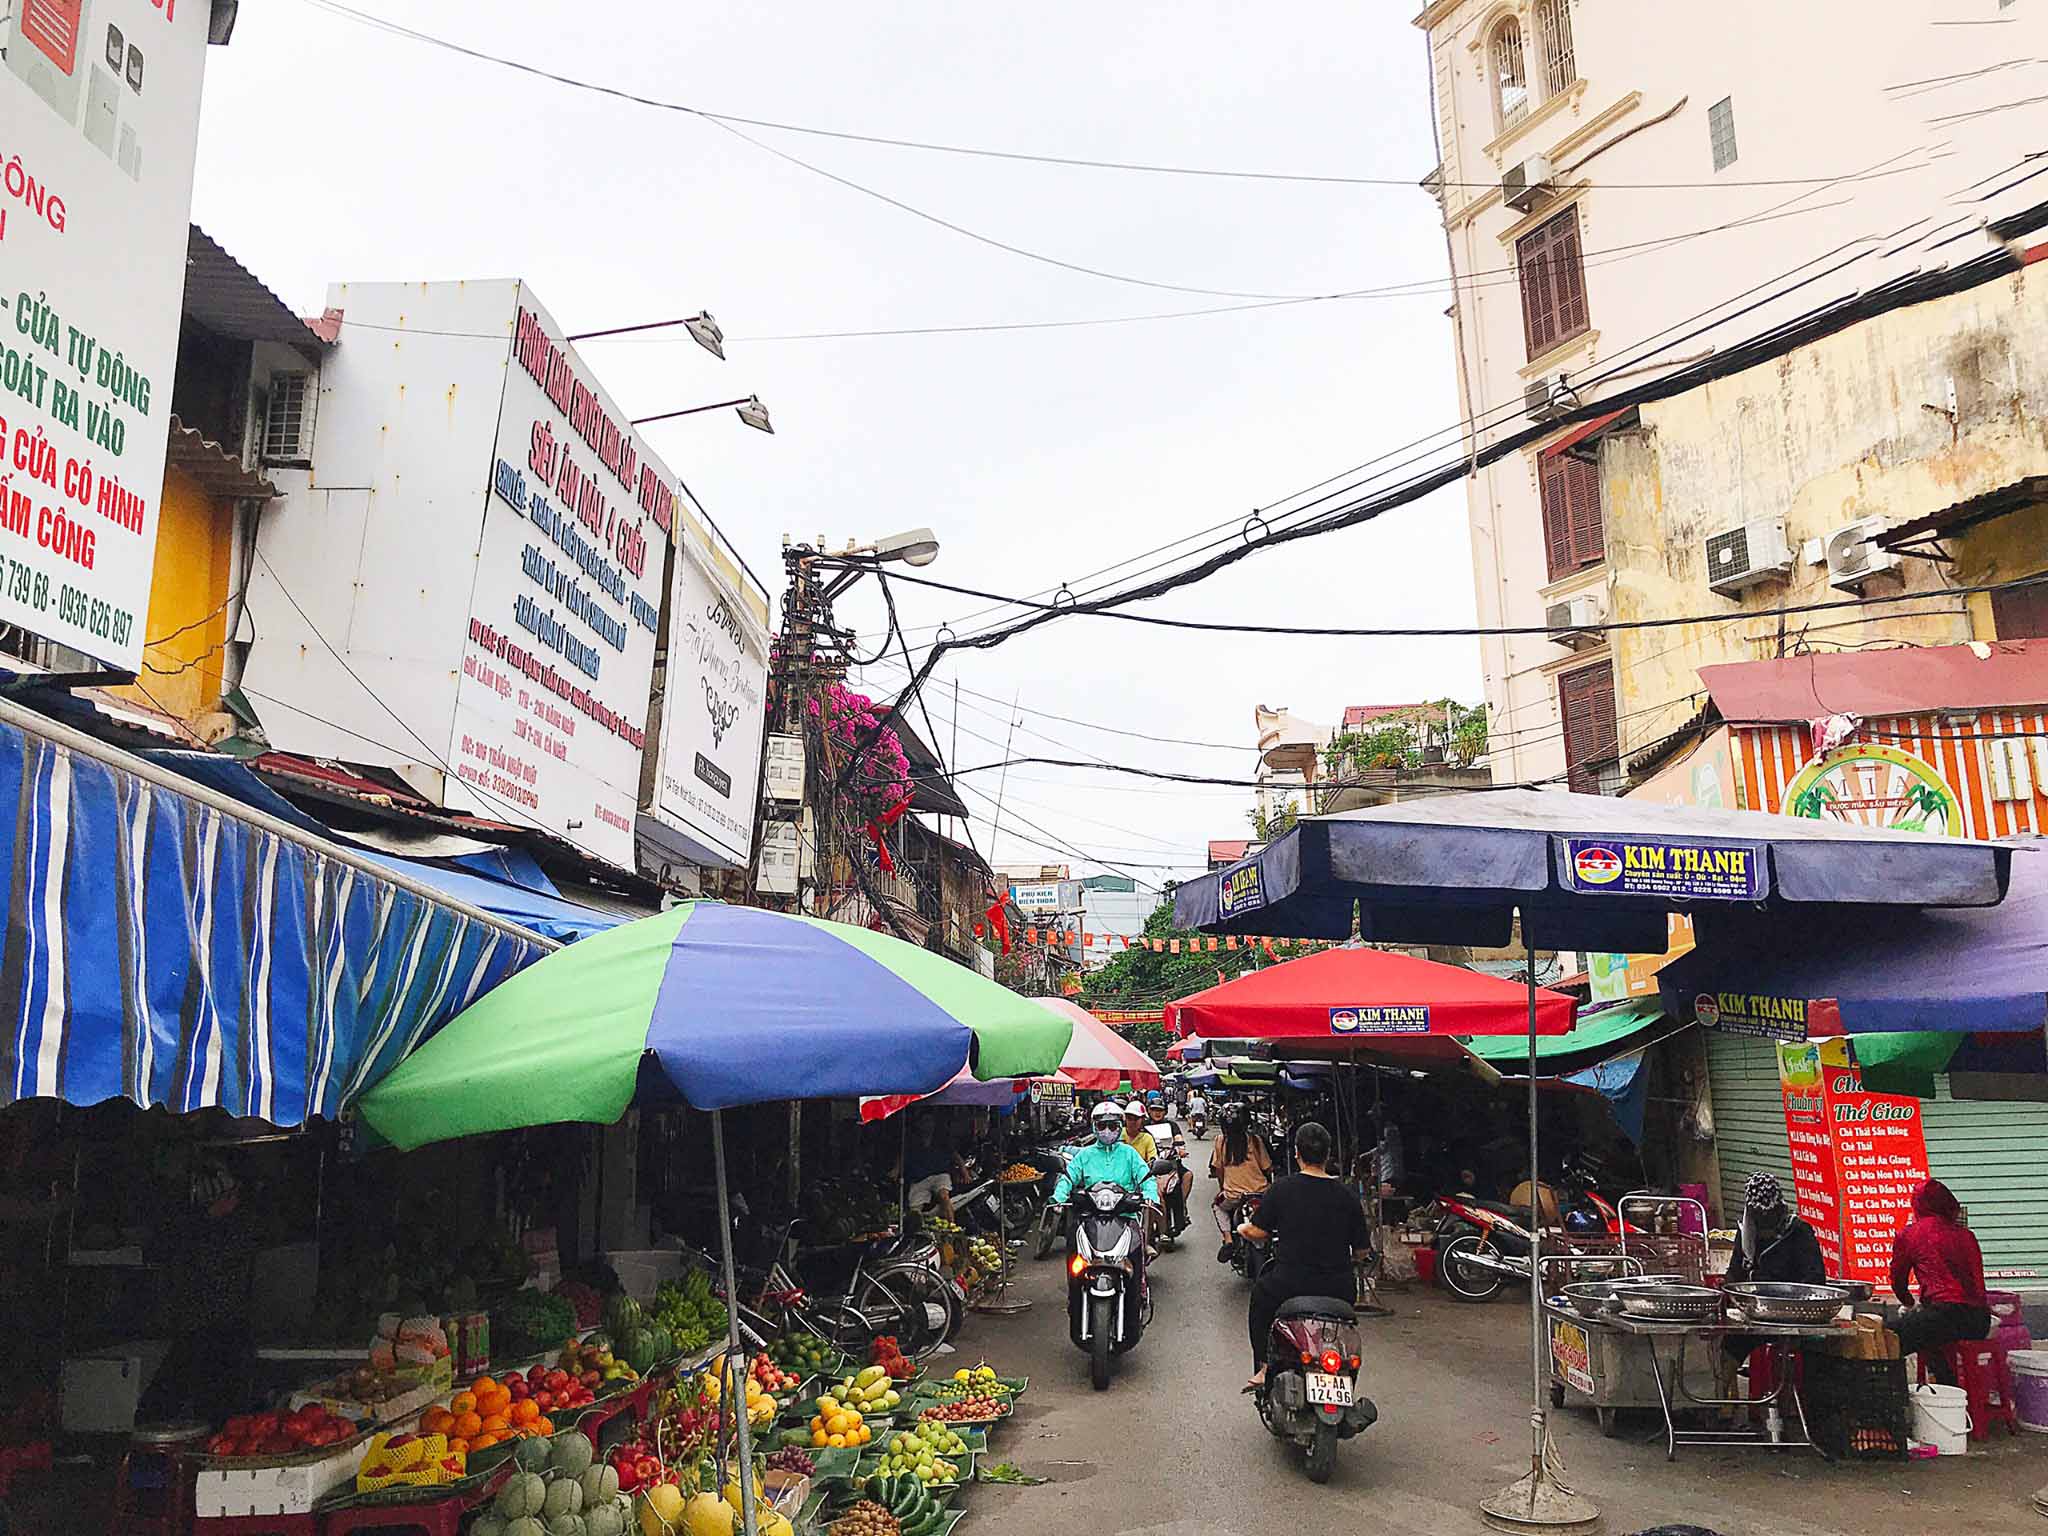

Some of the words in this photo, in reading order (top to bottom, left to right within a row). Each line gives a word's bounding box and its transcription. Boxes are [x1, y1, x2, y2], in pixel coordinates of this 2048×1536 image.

[0, 154, 66, 234] ÔNG
[15, 291, 60, 357] CỬA
[68, 326, 97, 384] TỰ
[96, 352, 151, 417] ĐỘNG
[514, 305, 550, 387] PHÒNG
[544, 345, 574, 418] KHÁM
[52, 378, 79, 433] RA
[86, 398, 125, 458] VÀO
[13, 424, 57, 491] CỬA
[64, 458, 93, 507] CÓ
[96, 473, 145, 537] HÌNH
[528, 420, 560, 488] SIÊU
[556, 442, 580, 512] ÂM
[577, 473, 606, 538] MÀU
[605, 507, 617, 550] 4
[616, 517, 648, 580] CHIỀU
[36, 506, 96, 571] CÔNG
[9, 559, 31, 606] 739
[33, 570, 49, 614] 68
[59, 582, 89, 630] 0936
[89, 596, 112, 640] 626
[113, 608, 134, 648] 897
[480, 624, 498, 653] BÁC
[1624, 846, 1666, 870] KIM
[1670, 848, 1746, 875] THANH
[1358, 1008, 1380, 1021] KIM
[1382, 1008, 1424, 1021] THANH
[1718, 993, 1746, 1015] KIM
[1749, 995, 1804, 1021] THANH
[1834, 1099, 1871, 1122] Thế
[1871, 1102, 1915, 1121] Giao
[1311, 1388, 1351, 1403] 124.96
[1314, 1375, 1345, 1390] 15-AA
